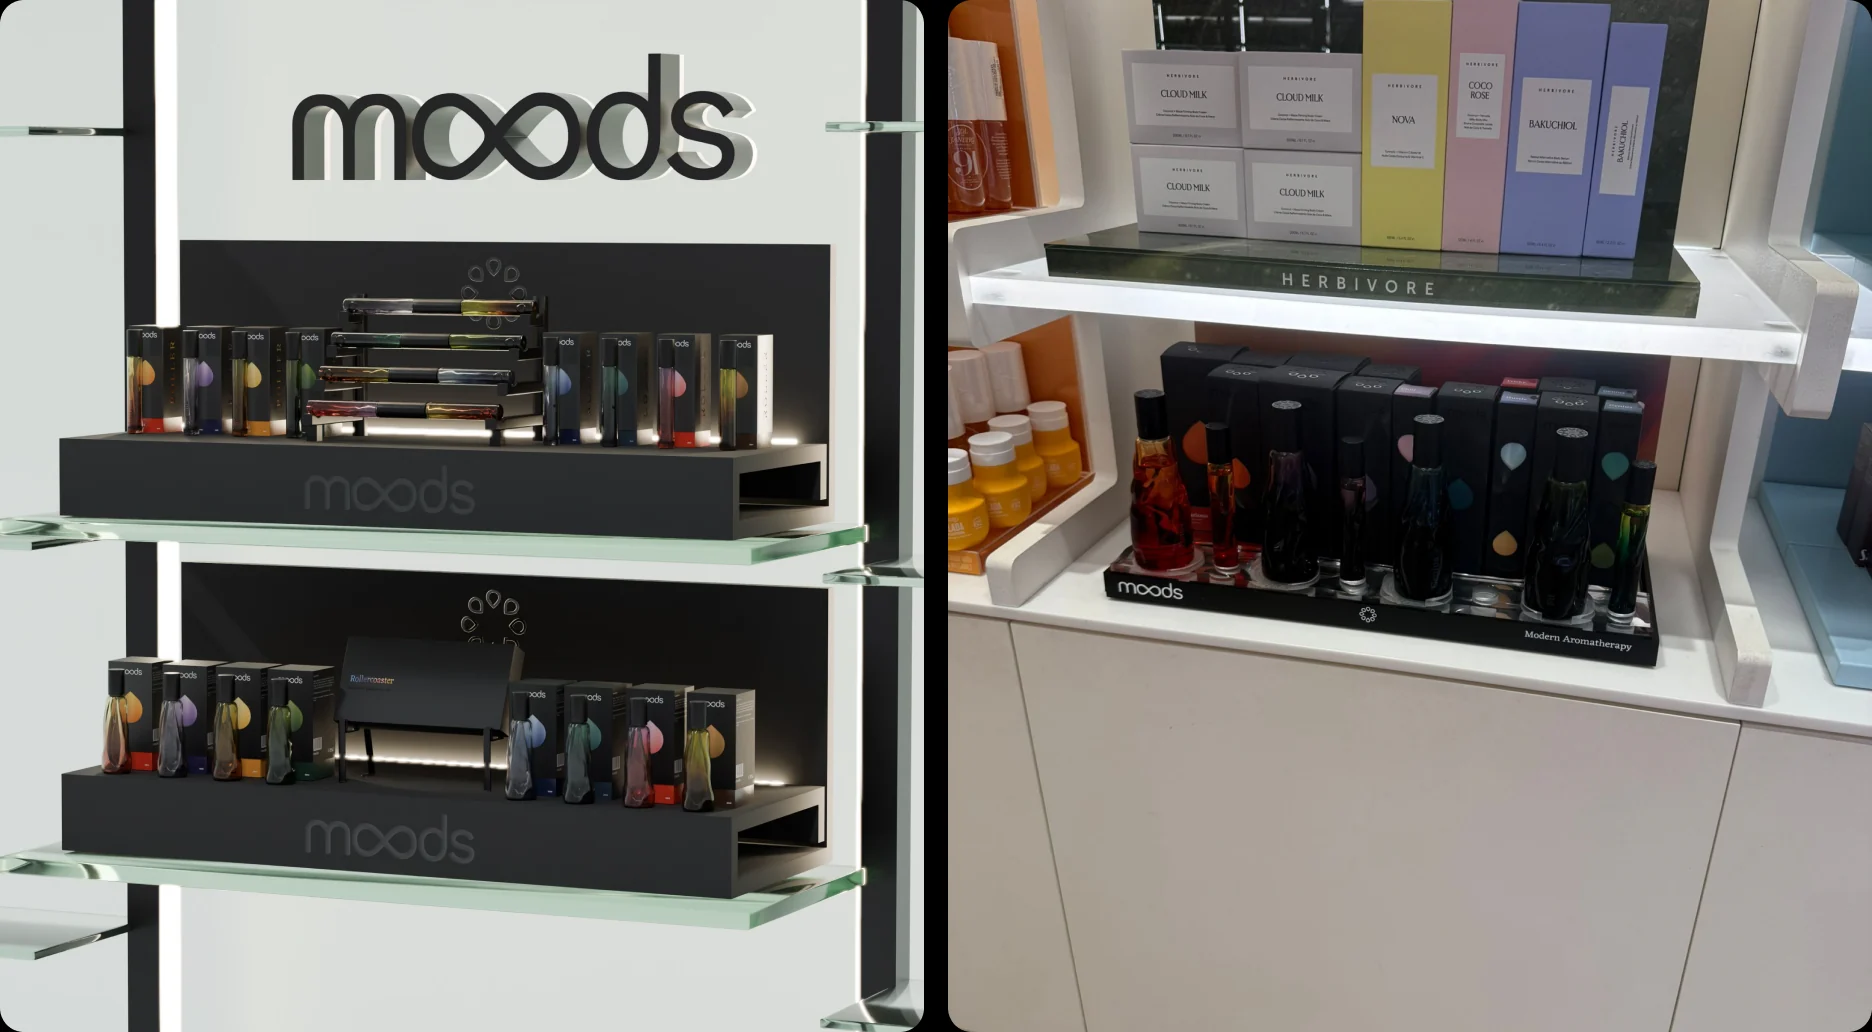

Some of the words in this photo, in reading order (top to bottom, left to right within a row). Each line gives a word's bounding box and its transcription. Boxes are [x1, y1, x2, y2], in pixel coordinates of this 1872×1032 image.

[1469, 81, 1493, 90] COCO
[1160, 89, 1188, 98] CLOUD
[1189, 91, 1207, 99] MILK
[1276, 93, 1304, 101] CLOUD
[1305, 94, 1323, 102] MILK
[1470, 91, 1490, 99] ROSE
[292, 53, 754, 181] moods
[1392, 115, 1415, 124] NOVA
[1529, 120, 1577, 130] BAKUCHIOL
[1617, 120, 1628, 163] BAKUCHIOL
[1167, 182, 1192, 191] CLOUD
[1193, 184, 1210, 192] MILK
[1279, 188, 1306, 197] CLOUD
[1308, 190, 1324, 198] MILK
[1282, 272, 1434, 296] HERBIVORE
[198, 332, 216, 340] oods
[301, 333, 319, 341] oods
[304, 466, 476, 515] moods
[1118, 581, 1184, 600] moods
[1524, 630, 1560, 642] Modern
[1562, 635, 1633, 652] Aromatherapy
[124, 668, 142, 676] oods
[350, 674, 395, 684] Rollercoaster
[305, 814, 476, 864] moods
